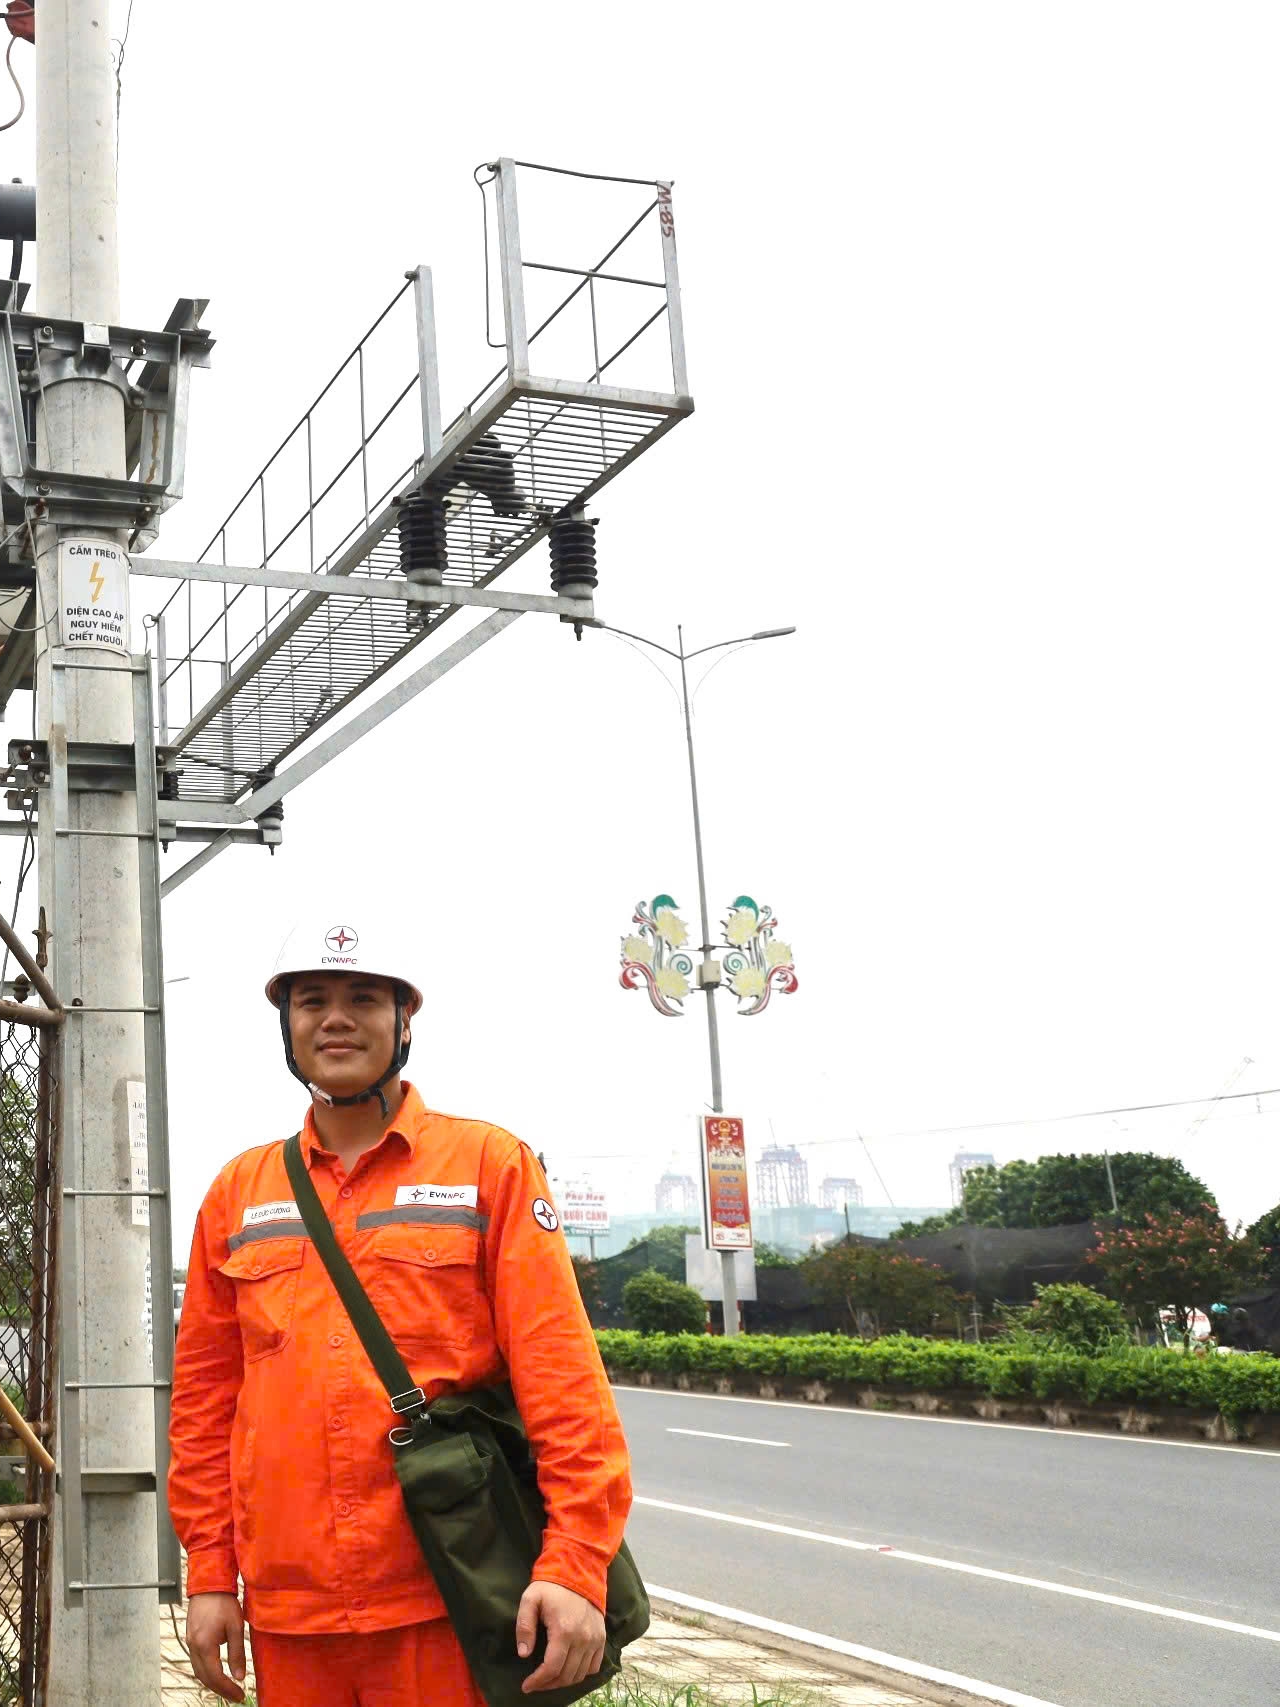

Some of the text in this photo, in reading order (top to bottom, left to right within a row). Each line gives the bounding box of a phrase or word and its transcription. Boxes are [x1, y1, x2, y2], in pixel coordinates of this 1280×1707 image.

[69, 544, 92, 556] CẤM
[94, 548, 116, 560] TRÈO
[66, 606, 124, 621] ĐIỆN CAO ÁP
[70, 620, 121, 633] NGUY HIỂM
[68, 630, 123, 646] CHẾT NGƯỜI
[321, 956, 358, 965] EVNNPC
[429, 1191, 465, 1199] EVNNPC
